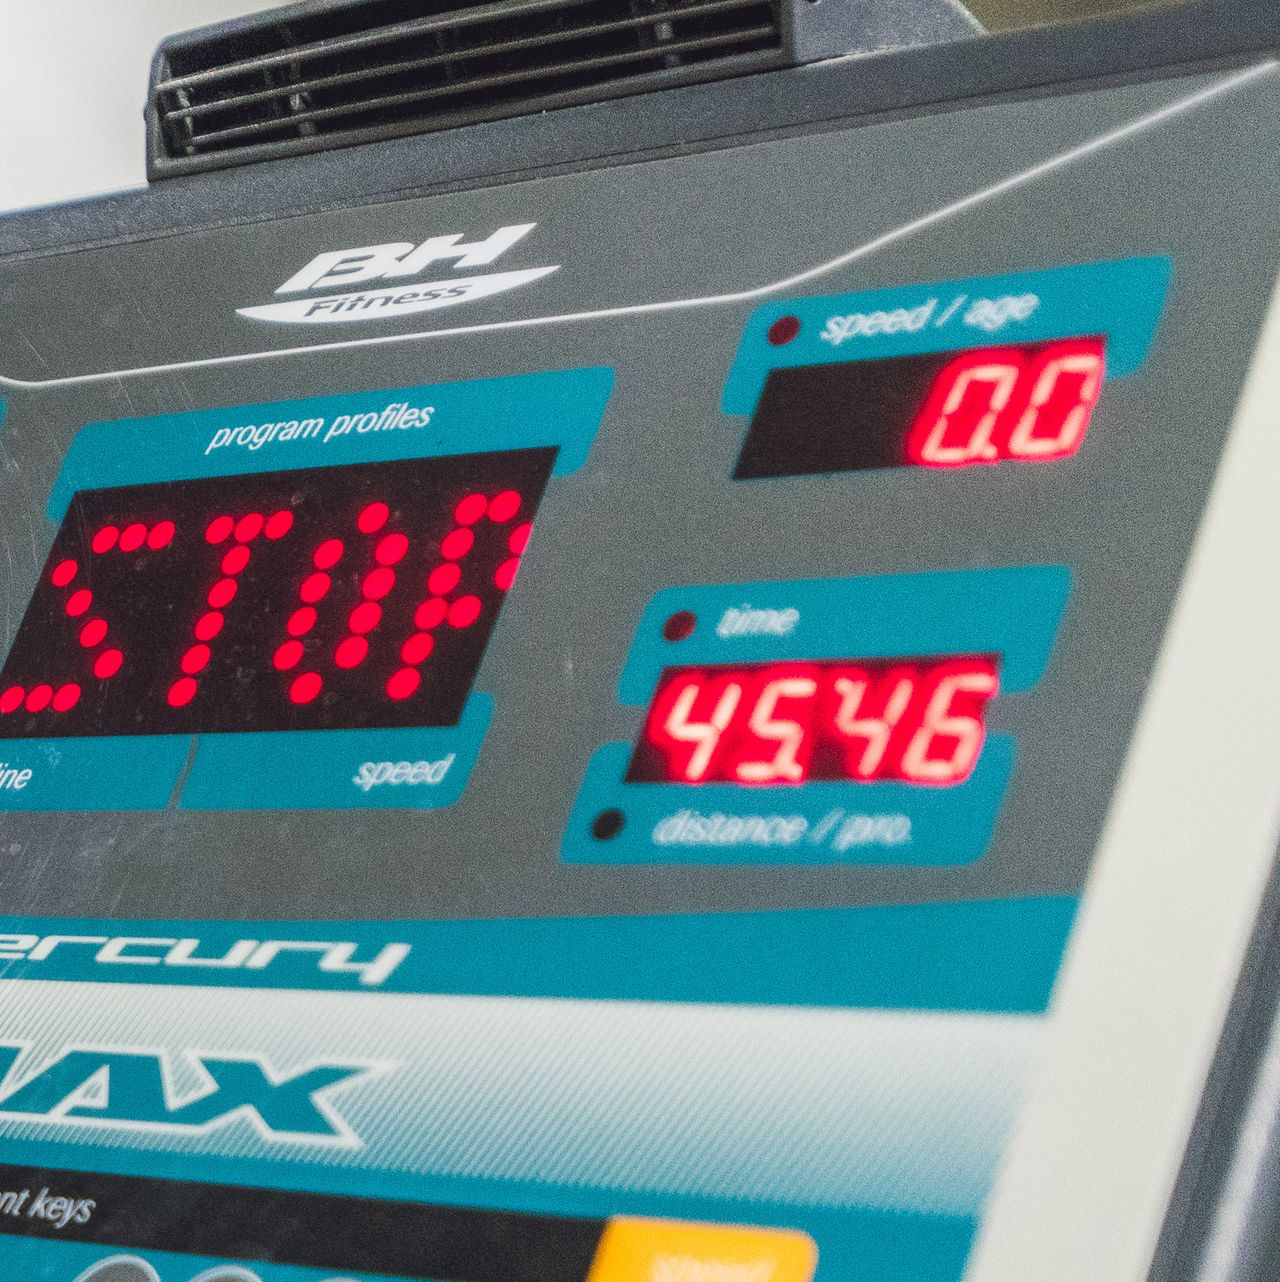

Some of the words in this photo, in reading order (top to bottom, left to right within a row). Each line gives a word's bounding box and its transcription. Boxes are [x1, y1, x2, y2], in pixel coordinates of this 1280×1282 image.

[274, 222, 538, 294] BH
[302, 283, 472, 318] Fitness
[821, 297, 938, 344] speed
[963, 291, 1040, 332] age
[205, 417, 324, 454] program
[323, 401, 435, 442] profiles
[716, 604, 801, 637] time
[353, 754, 456, 788] speed
[652, 811, 808, 845] distance
[29, 1185, 97, 1226] keys
